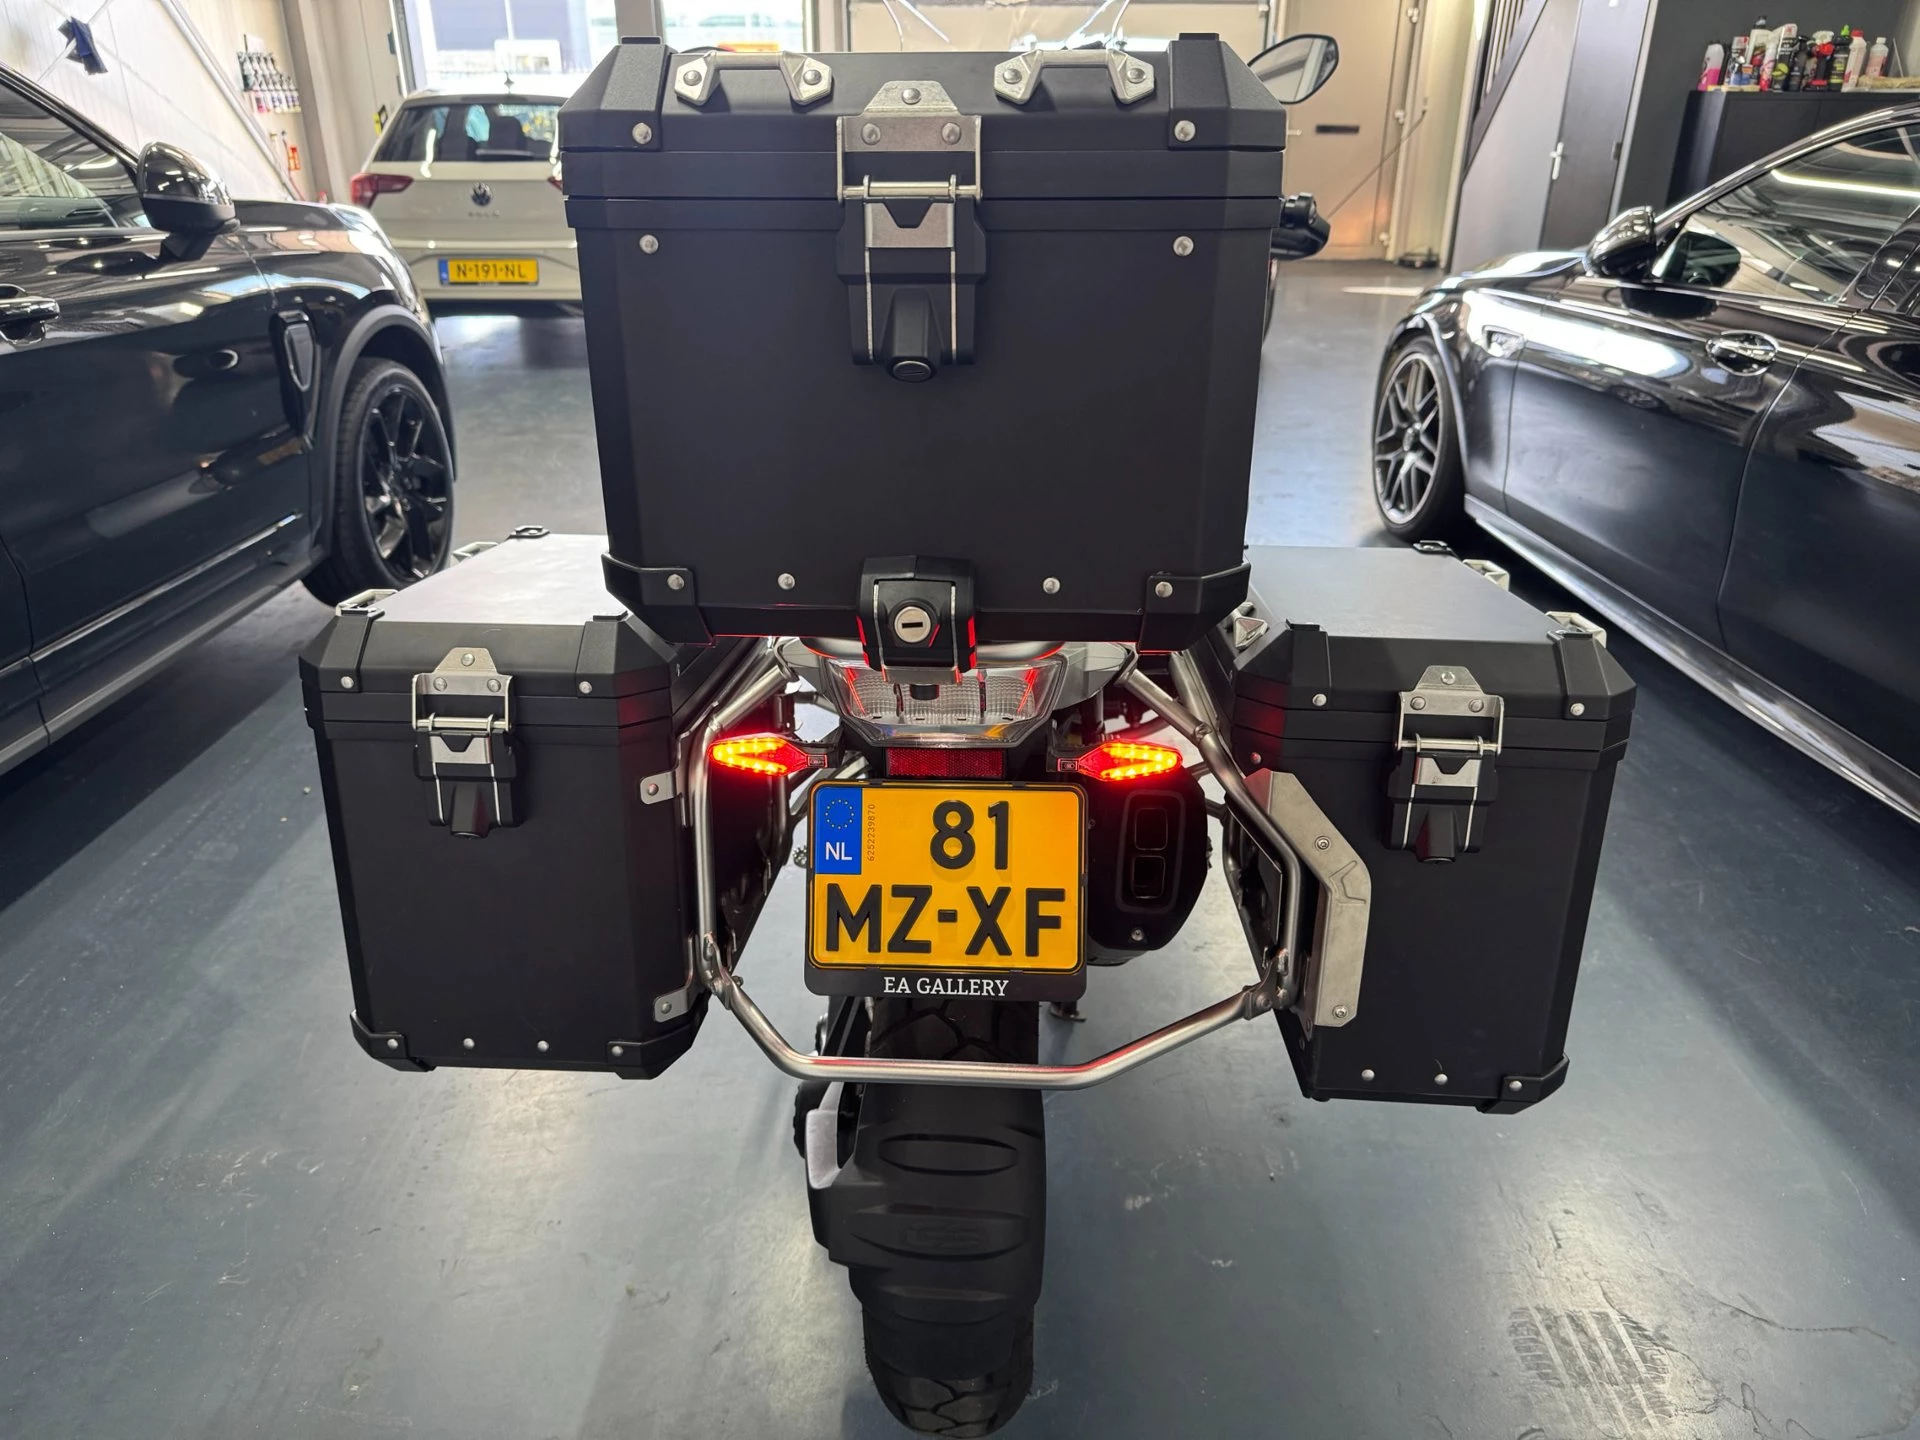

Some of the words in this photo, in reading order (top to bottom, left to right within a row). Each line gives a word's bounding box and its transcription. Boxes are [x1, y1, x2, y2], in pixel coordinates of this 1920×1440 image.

[456, 263, 526, 279] N-191-NL
[824, 841, 853, 861] NL
[866, 803, 876, 862] 6252239870
[930, 800, 1009, 870] 81
[825, 882, 1066, 957] MZ-XF
[882, 976, 912, 994] EA
[916, 977, 1010, 997] GALLERY
